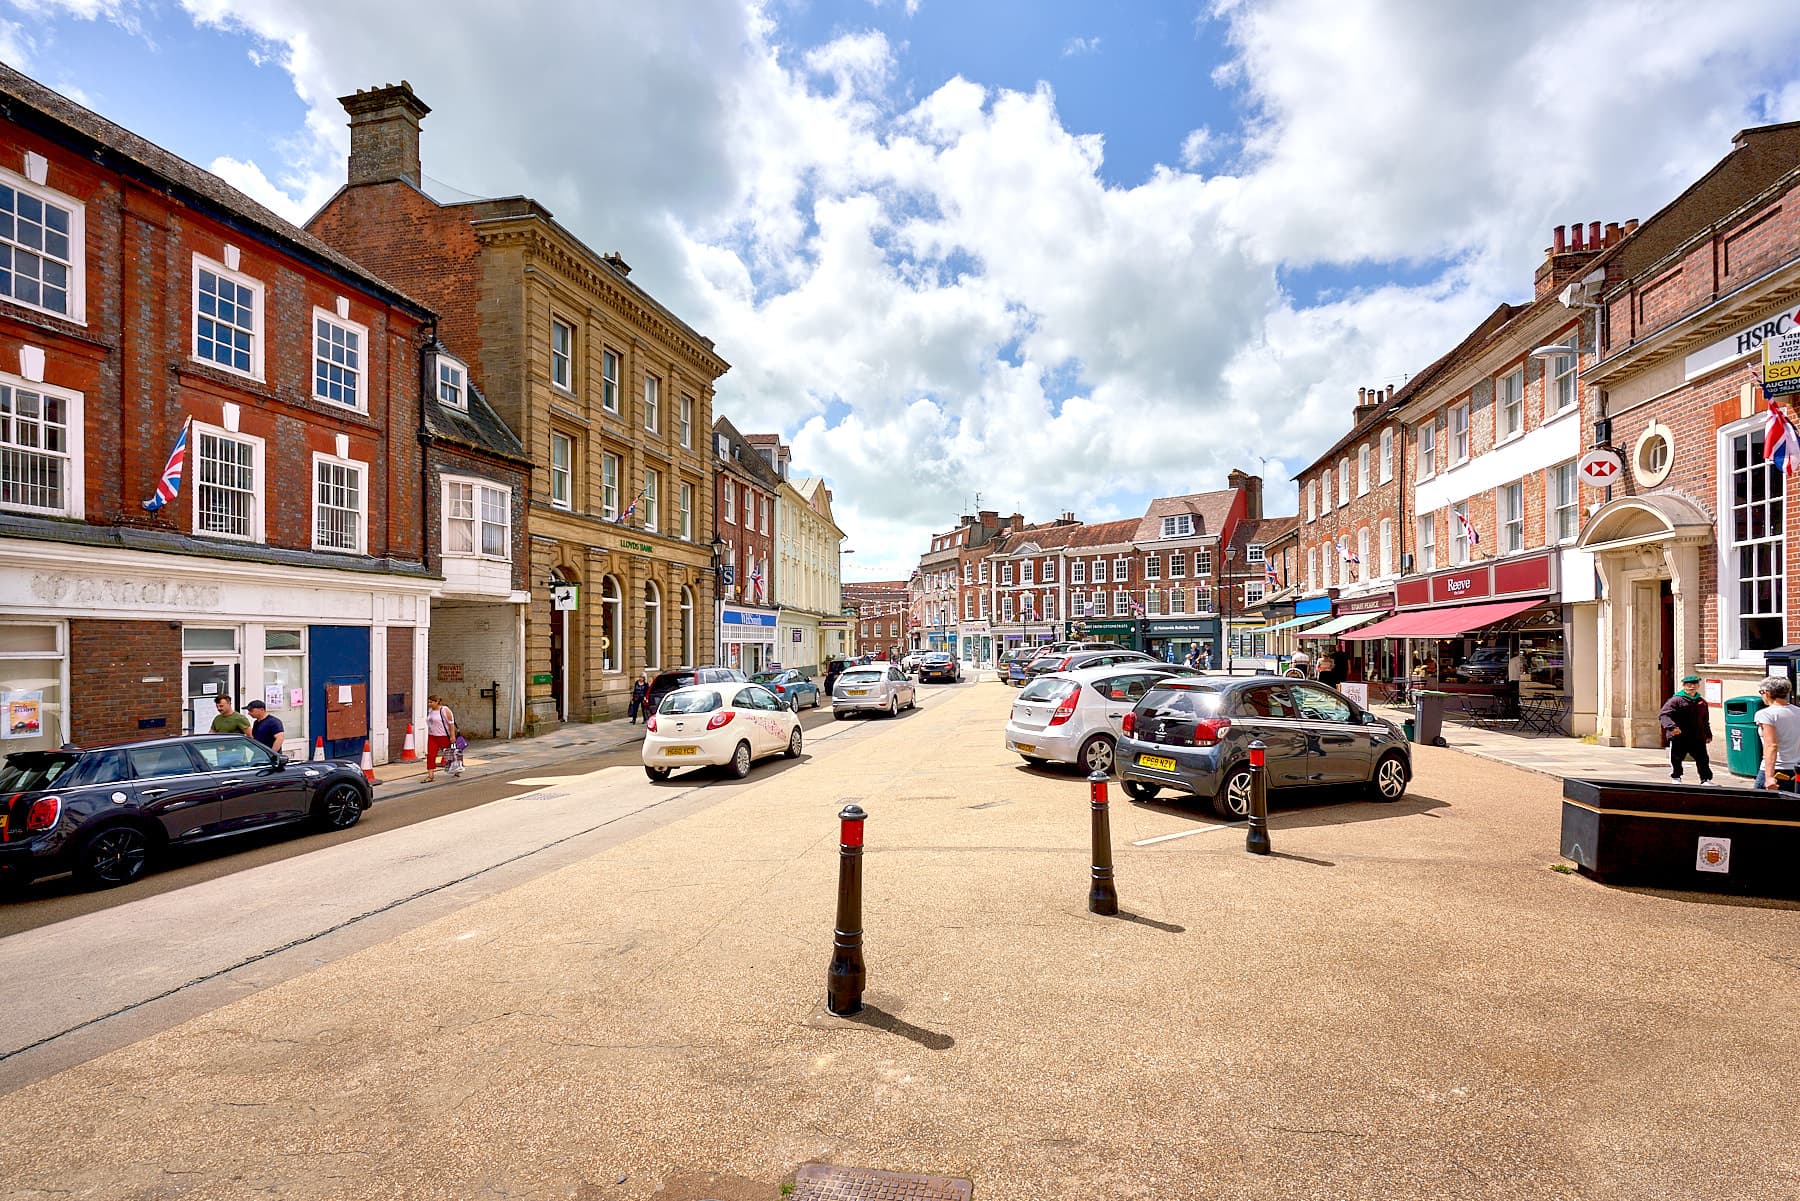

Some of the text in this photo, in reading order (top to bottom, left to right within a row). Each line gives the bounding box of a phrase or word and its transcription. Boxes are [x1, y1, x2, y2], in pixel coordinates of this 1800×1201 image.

[1736, 312, 1791, 355] HSBC
[620, 539, 640, 550] LLOYDS
[1447, 578, 1471, 592] Reeve
